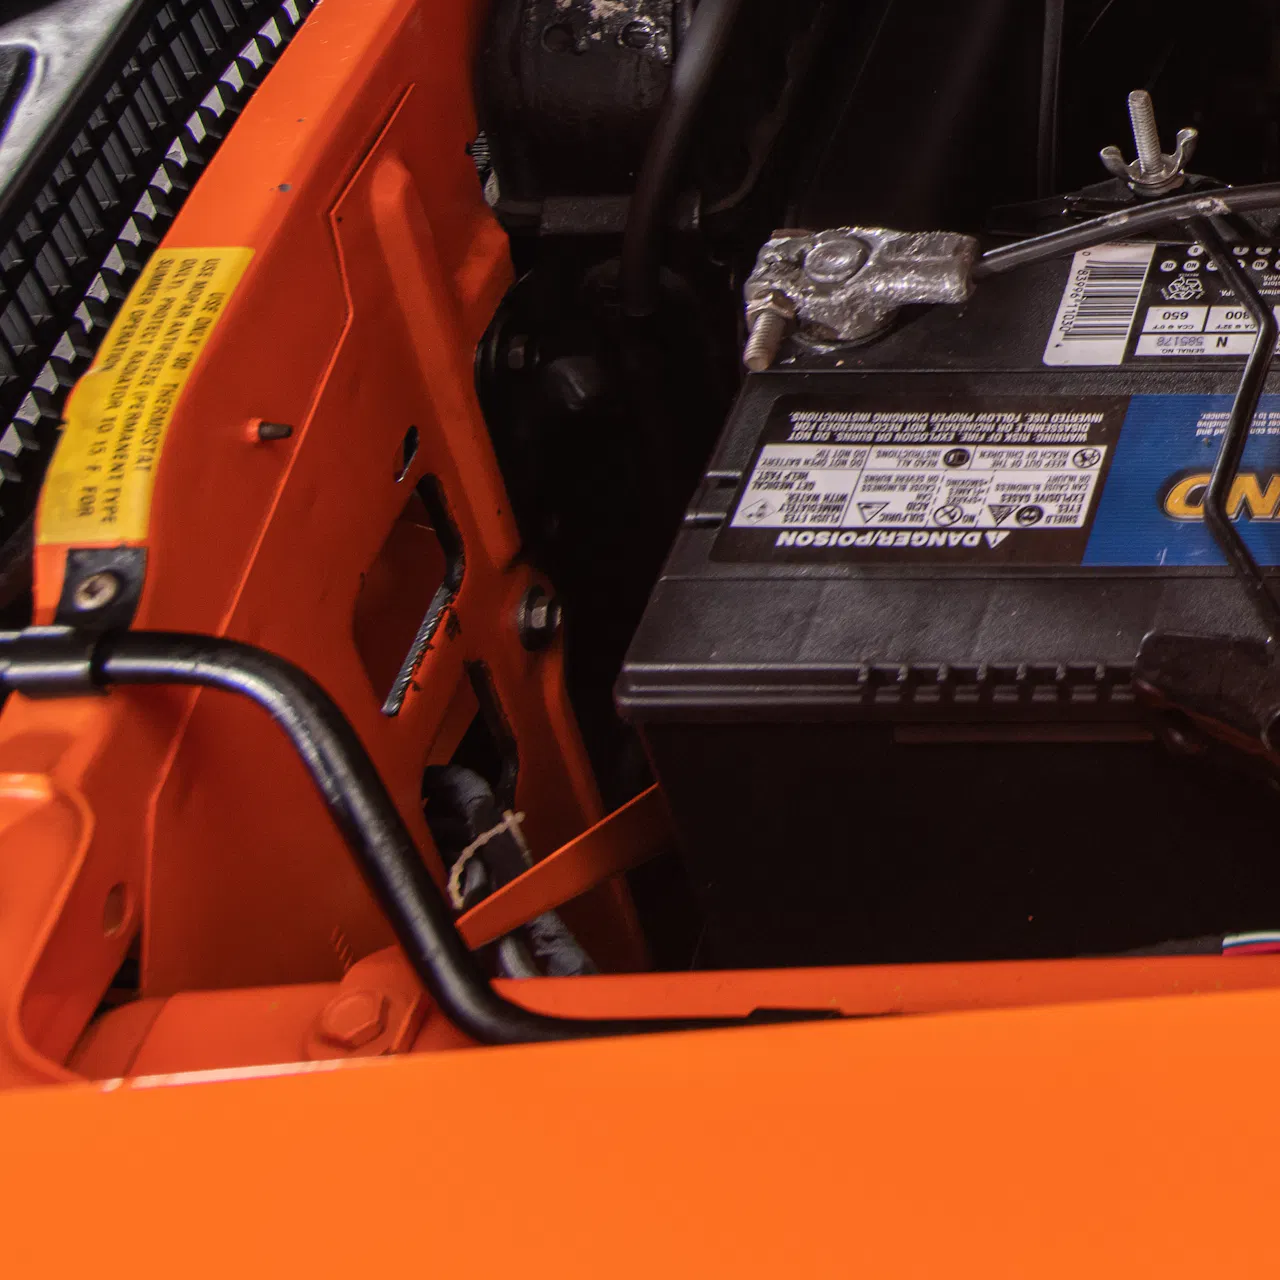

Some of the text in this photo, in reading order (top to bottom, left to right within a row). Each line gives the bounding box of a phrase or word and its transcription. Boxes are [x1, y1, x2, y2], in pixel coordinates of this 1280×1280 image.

[136, 258, 175, 306] SUMMER
[175, 281, 208, 318] MOPAR
[1161, 311, 1188, 319] 650
[137, 297, 177, 345] PROTECT
[1215, 336, 1228, 347] N
[138, 321, 184, 387] ANTIFREEZE
[105, 350, 148, 409] RADIATOR
[96, 416, 117, 434] TO
[134, 382, 180, 472] THERMOSTAT
[783, 471, 810, 481] HELP
[750, 481, 816, 490] GET MEDICAL
[78, 486, 98, 517] FOR
[821, 493, 849, 502] WITH
[999, 493, 1086, 503] EXPLOSIVE GASES
[100, 486, 121, 524] TYPE
[776, 503, 845, 512] IMMEDIATELY
[904, 502, 929, 511] ACID
[808, 513, 841, 523] FLUSH
[876, 513, 926, 523] SULFURIC
[1043, 514, 1079, 524] SHIELD
[773, 529, 984, 546] DANGER/POISON
